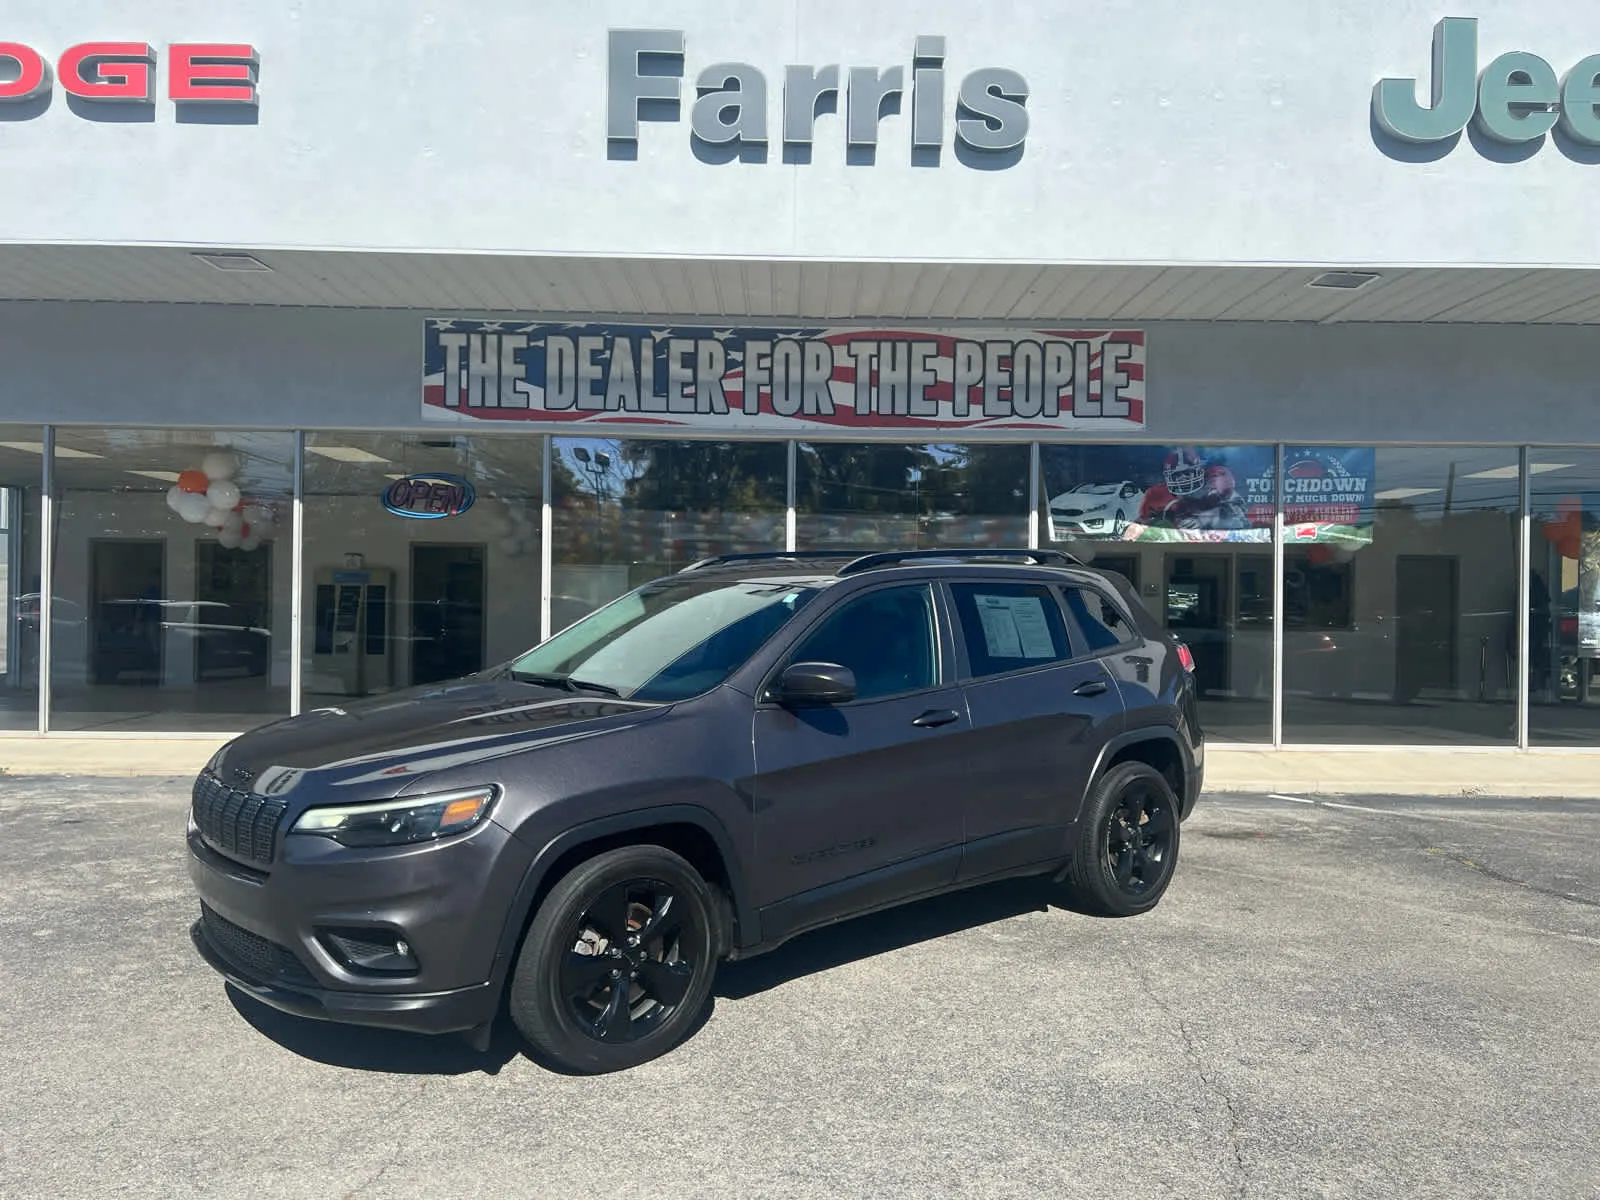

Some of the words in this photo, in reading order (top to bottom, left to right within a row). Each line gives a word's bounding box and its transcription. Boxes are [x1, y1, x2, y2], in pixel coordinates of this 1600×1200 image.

[606, 27, 1031, 150] Farris
[438, 331, 530, 409] THE
[545, 334, 730, 415] DEALER
[743, 338, 835, 417] FOR
[848, 340, 938, 417] THE
[953, 340, 1132, 418] PEOPLE
[390, 479, 465, 514] OPEN
[1246, 478, 1367, 493] TOCHDOWN
[1247, 494, 1268, 503] FOR
[1295, 493, 1327, 503] MUCH
